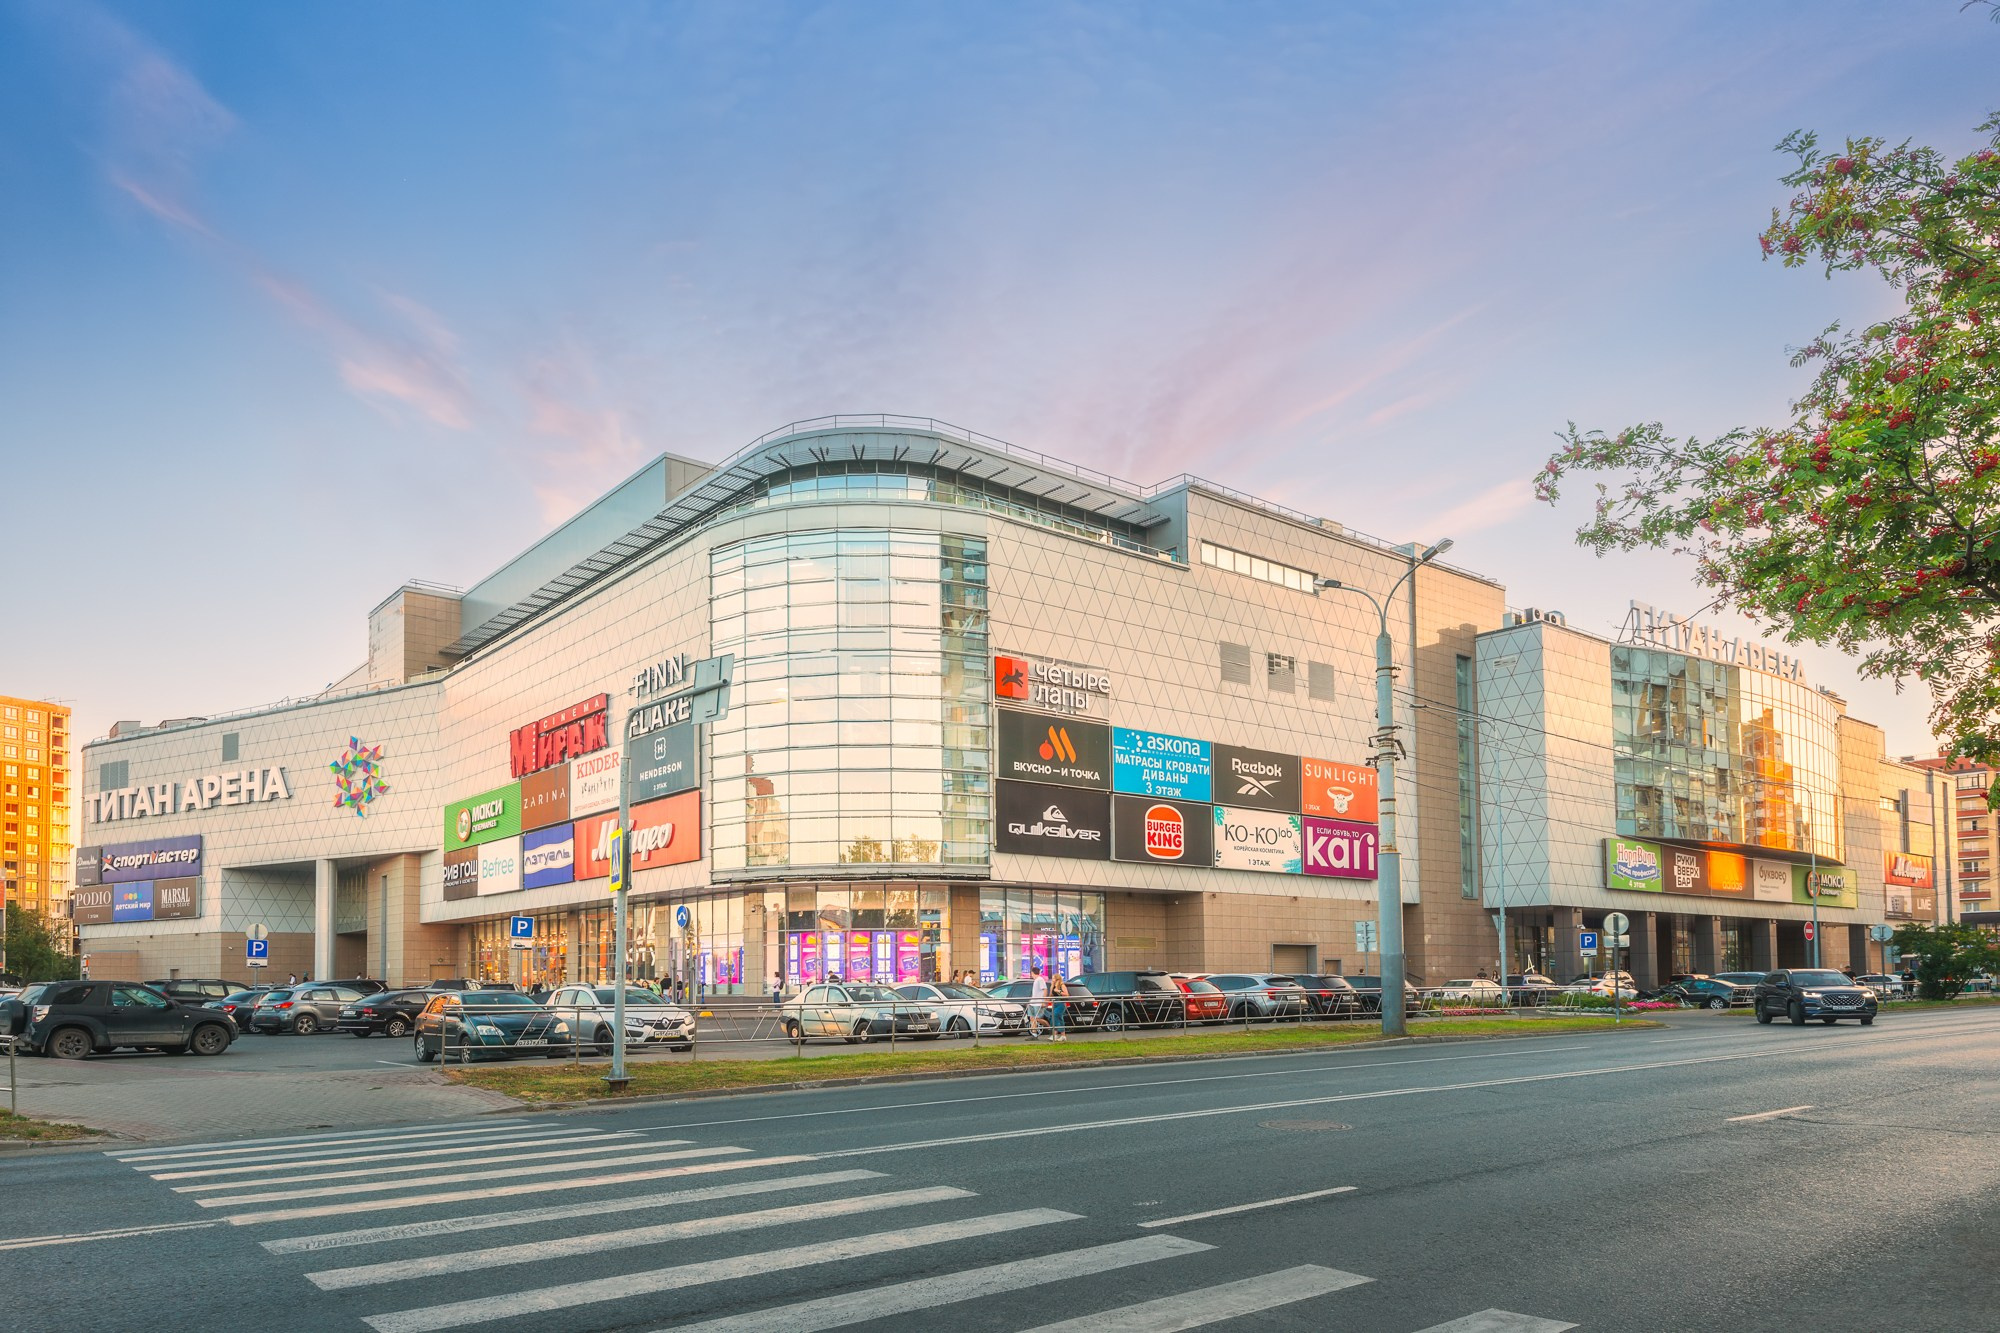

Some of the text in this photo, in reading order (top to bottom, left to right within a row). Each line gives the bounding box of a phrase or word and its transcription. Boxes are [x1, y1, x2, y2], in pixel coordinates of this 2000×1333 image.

[1630, 599, 1808, 685] ТИТАН АРЕНА
[634, 652, 684, 698] FINN
[543, 699, 600, 729] CINEMA
[629, 698, 692, 738] FLARE
[1147, 735, 1200, 756] askona
[576, 751, 620, 780] KINDER
[639, 761, 682, 782] HENDERSON
[1013, 761, 1052, 775] ВКУСНО
[1061, 767, 1069, 777] И
[1070, 768, 1100, 781] ТОЧКА
[1115, 752, 1210, 776] МАТРАСЫ КРОВАТИ
[1231, 757, 1282, 777] Reebok
[1142, 768, 1189, 785] ДИВАНЫ
[1305, 763, 1375, 786] SUNLIGHT
[84, 766, 291, 824] ТИТАН АРЕНА
[523, 787, 566, 810] ZARINA
[1146, 781, 1182, 797] 3 этаж
[1147, 821, 1182, 833] BURGER
[1147, 832, 1182, 848] KING
[1234, 845, 1258, 853] КОРЕЙСКАЯ
[1306, 826, 1375, 871] kari
[460, 860, 478, 878] ГОШ
[482, 857, 514, 879] Befree
[1676, 855, 1695, 866] РУКИ
[1677, 877, 1691, 887] БАР
[1759, 865, 1787, 884] буквоед
[76, 890, 112, 906] PODIO
[161, 887, 191, 904] MARSAL
[115, 902, 151, 911] детский мир
[517, 920, 529, 934] P
[252, 941, 265, 956] P
[1584, 936, 1593, 947] P
